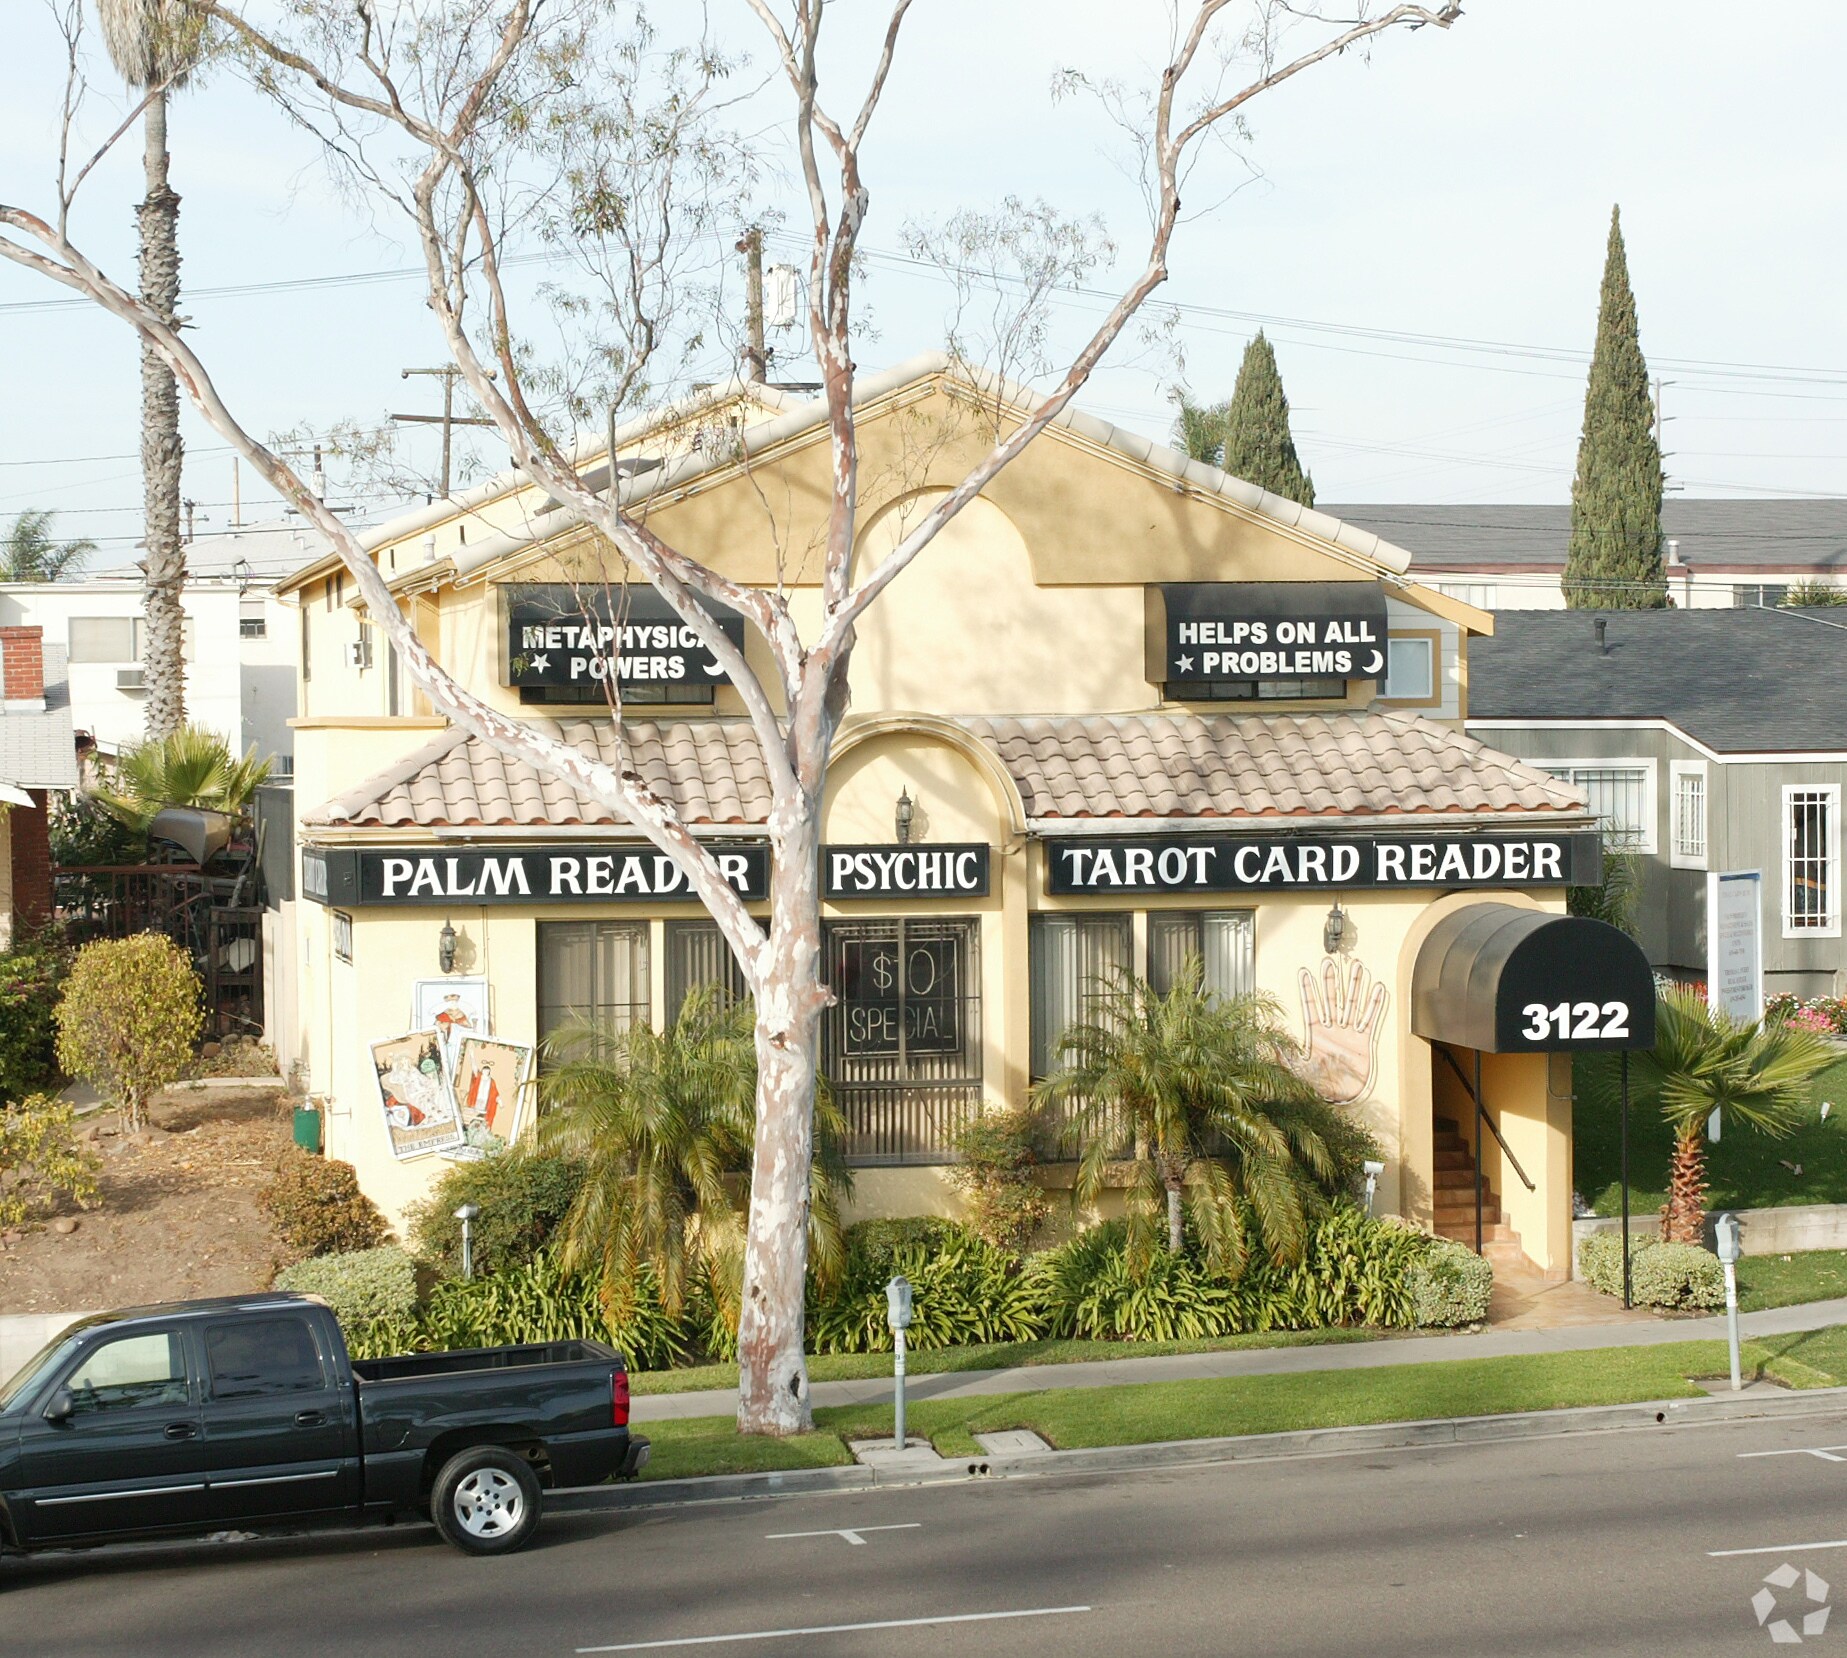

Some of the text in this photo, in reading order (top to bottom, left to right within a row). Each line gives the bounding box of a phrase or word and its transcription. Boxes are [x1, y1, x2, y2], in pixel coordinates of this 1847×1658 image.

[522, 625, 723, 649] METAPHYSIC
[1179, 621, 1376, 644] HELPS ON ALL
[570, 656, 685, 680] POWERS
[1203, 651, 1352, 674] PROBLEMS
[381, 854, 750, 896] PALM READR
[831, 852, 978, 891] PSYCHIC
[1061, 842, 1563, 886] TAROT CARD READER
[873, 949, 935, 997] $0
[850, 1006, 952, 1042] SPECIA
[1521, 1001, 1629, 1041] 3122
